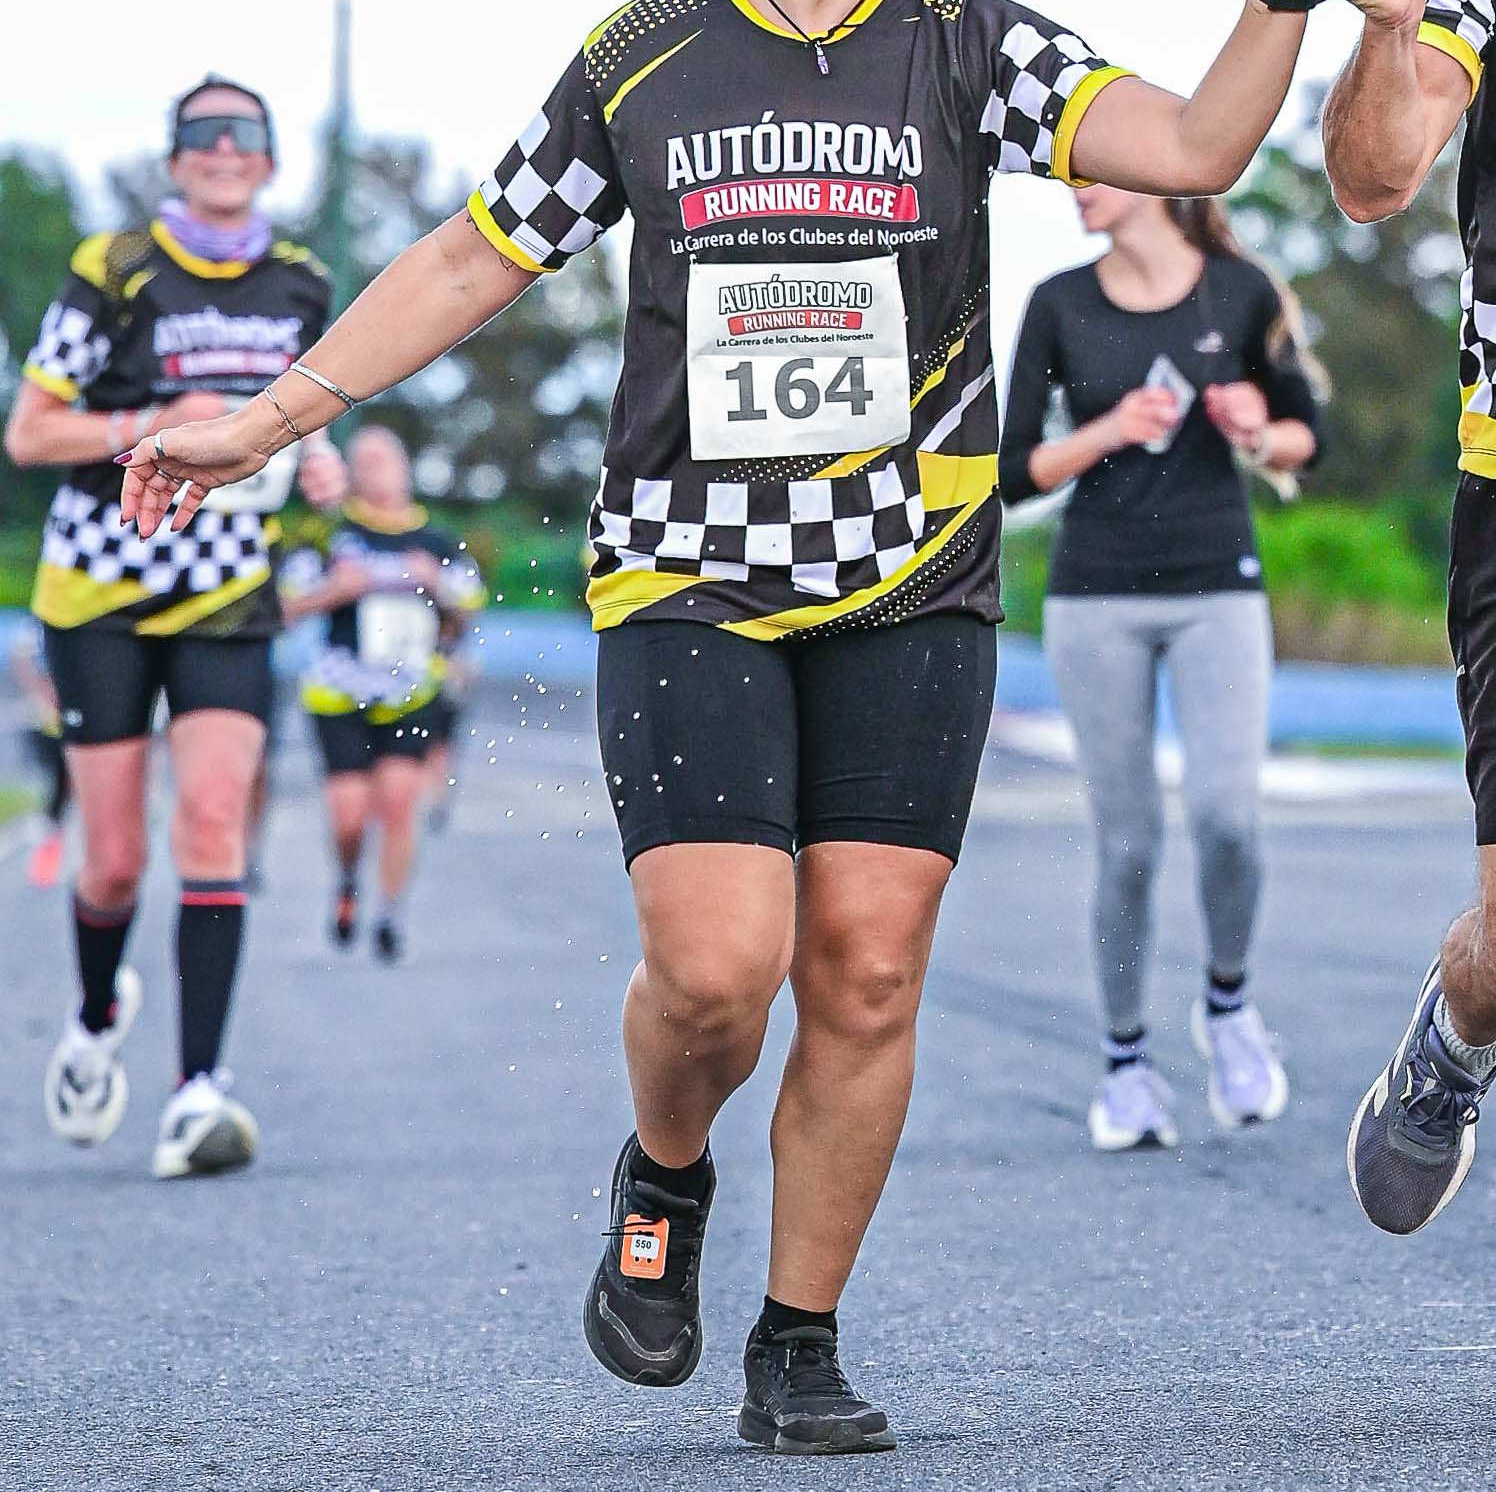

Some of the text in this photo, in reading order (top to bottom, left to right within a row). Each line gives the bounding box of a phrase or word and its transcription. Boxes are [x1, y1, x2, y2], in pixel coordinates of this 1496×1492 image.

[666, 109, 923, 191] AUTÓDROMO
[703, 182, 897, 220] RUNNING RACE
[670, 226, 938, 255] La Carrera de los Clubes del Noroeste
[719, 273, 873, 315] AUTÓDROMO
[742, 311, 848, 331] RUNNING RACE
[716, 331, 874, 347] La Carrera de los Clubes del Noroeste
[725, 356, 874, 422] 164
[635, 1239, 652, 1249] 550
